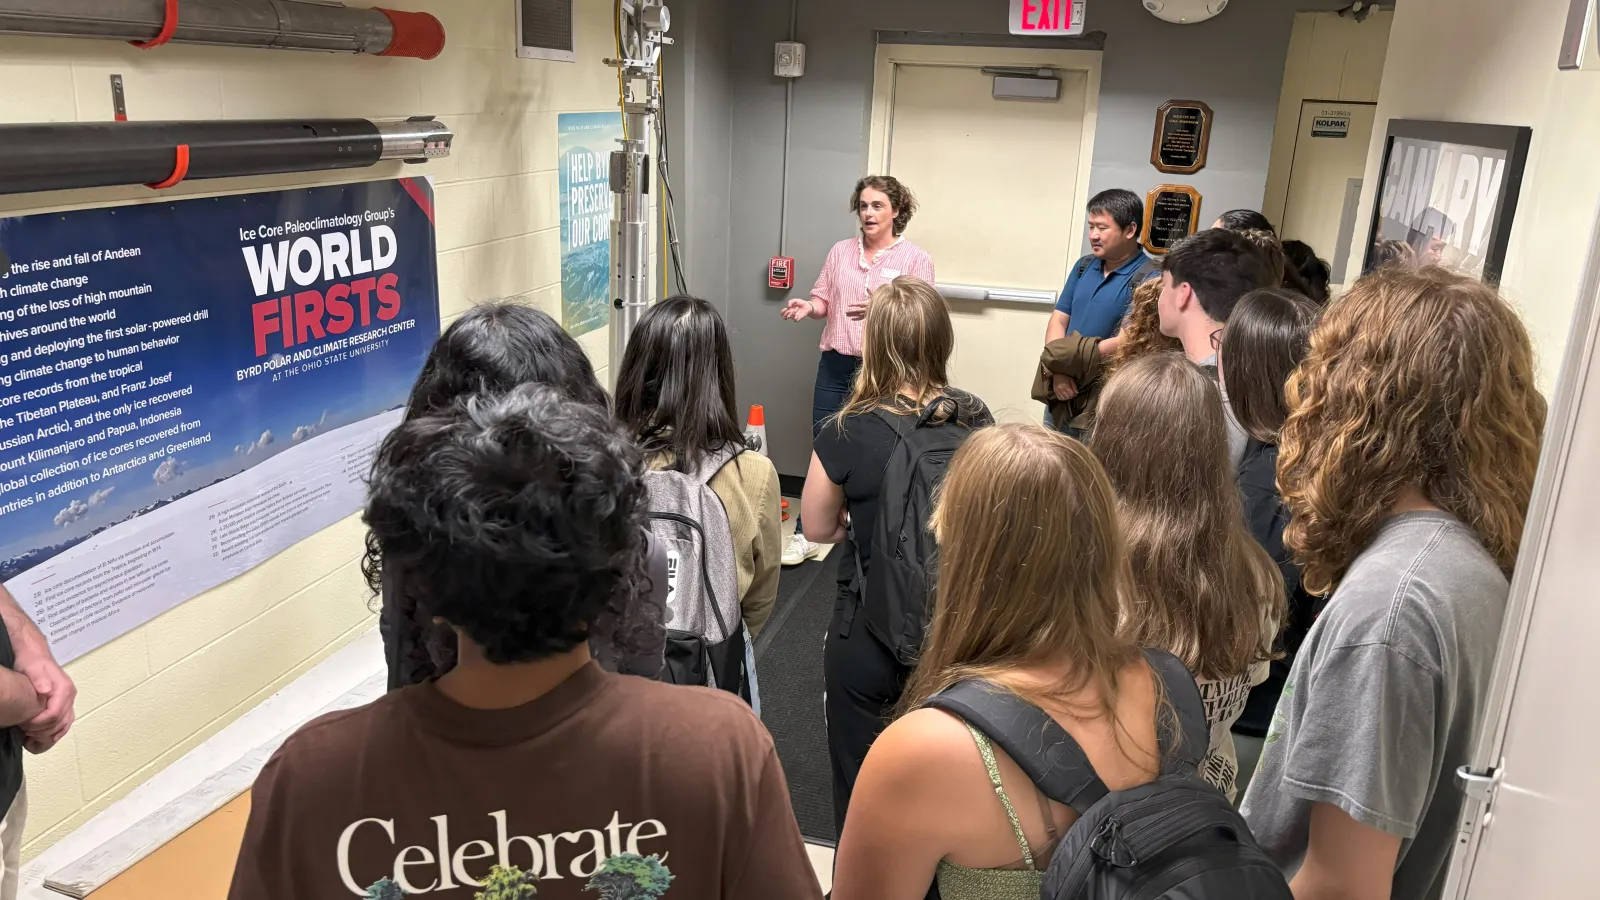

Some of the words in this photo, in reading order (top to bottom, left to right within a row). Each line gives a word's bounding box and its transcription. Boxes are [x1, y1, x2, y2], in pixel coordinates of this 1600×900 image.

[1315, 119, 1347, 127] KOLPAK
[572, 152, 593, 183] HELP
[596, 151, 610, 180] BY
[240, 228, 256, 241] Ice
[259, 225, 283, 237] Core
[285, 213, 362, 234] Paleoclimatology
[365, 207, 395, 221] Group's
[572, 217, 590, 248] OUR
[593, 212, 610, 242] COR
[10, 263, 29, 274] the
[31, 260, 50, 271] rise
[53, 255, 72, 268] and
[74, 252, 90, 264] fall
[91, 250, 102, 262] of
[104, 248, 141, 260] Andean
[242, 225, 397, 296] WORLD
[10, 282, 48, 296] climate
[50, 276, 88, 289] change
[17, 304, 28, 317] of
[29, 303, 47, 314] the
[49, 299, 70, 310] loss
[72, 294, 83, 306] of
[84, 291, 106, 304] high
[109, 283, 152, 299] mountain
[0, 329, 28, 342] hives
[31, 318, 67, 335] around
[69, 316, 86, 327] the
[88, 309, 116, 323] world
[11, 347, 32, 361] and
[34, 337, 85, 355] deploying
[86, 333, 103, 344] the
[105, 327, 124, 340] first
[125, 313, 191, 335] solar-powered
[193, 309, 208, 321] drill
[252, 273, 400, 357] FIRSTS
[14, 365, 53, 381] climate
[55, 356, 93, 371] change
[94, 353, 105, 362] to
[107, 345, 139, 359] human
[141, 335, 180, 351] behavior
[237, 364, 262, 381] BYRD
[264, 355, 291, 372] POLAR
[294, 349, 311, 362] AND
[313, 339, 348, 357] CLIMATE
[349, 328, 387, 346] RESEARCH
[388, 320, 415, 335] CENTER
[272, 372, 281, 382] AT
[284, 367, 299, 378] THE
[302, 360, 322, 372] OHIO
[325, 353, 347, 365] STATE
[350, 339, 389, 357] UNIVERSITY
[15, 406, 57, 423] Tibetan
[59, 395, 100, 412] Plateau,
[102, 386, 119, 400] and
[121, 381, 146, 394] Franz
[148, 372, 172, 387] Josef
[23, 382, 63, 400] records
[65, 377, 89, 389] from
[90, 372, 107, 383] the
[108, 361, 143, 378] tropical
[0, 434, 34, 450] ussian
[37, 419, 72, 439] Arctic),
[74, 413, 93, 428] and
[95, 411, 111, 421] the
[113, 403, 132, 416] only
[134, 400, 147, 410] ice
[149, 385, 192, 405] recovered
[0, 456, 26, 472] ount
[28, 439, 85, 463] Kilimanjaro
[87, 429, 105, 444] and
[107, 422, 138, 437] Papua,
[140, 407, 181, 427] Indonesia
[30, 461, 79, 483] collection
[82, 453, 91, 465] of
[93, 451, 107, 461] ice
[110, 442, 134, 455] cores
[136, 424, 179, 448] recovered
[180, 420, 200, 438] from
[35, 492, 45, 502] in
[48, 477, 88, 497] addition
[90, 473, 100, 482] to
[103, 456, 146, 478] Antarctica
[149, 446, 165, 461] and
[166, 432, 212, 454] Greenland
[337, 809, 669, 898] Celebrate
